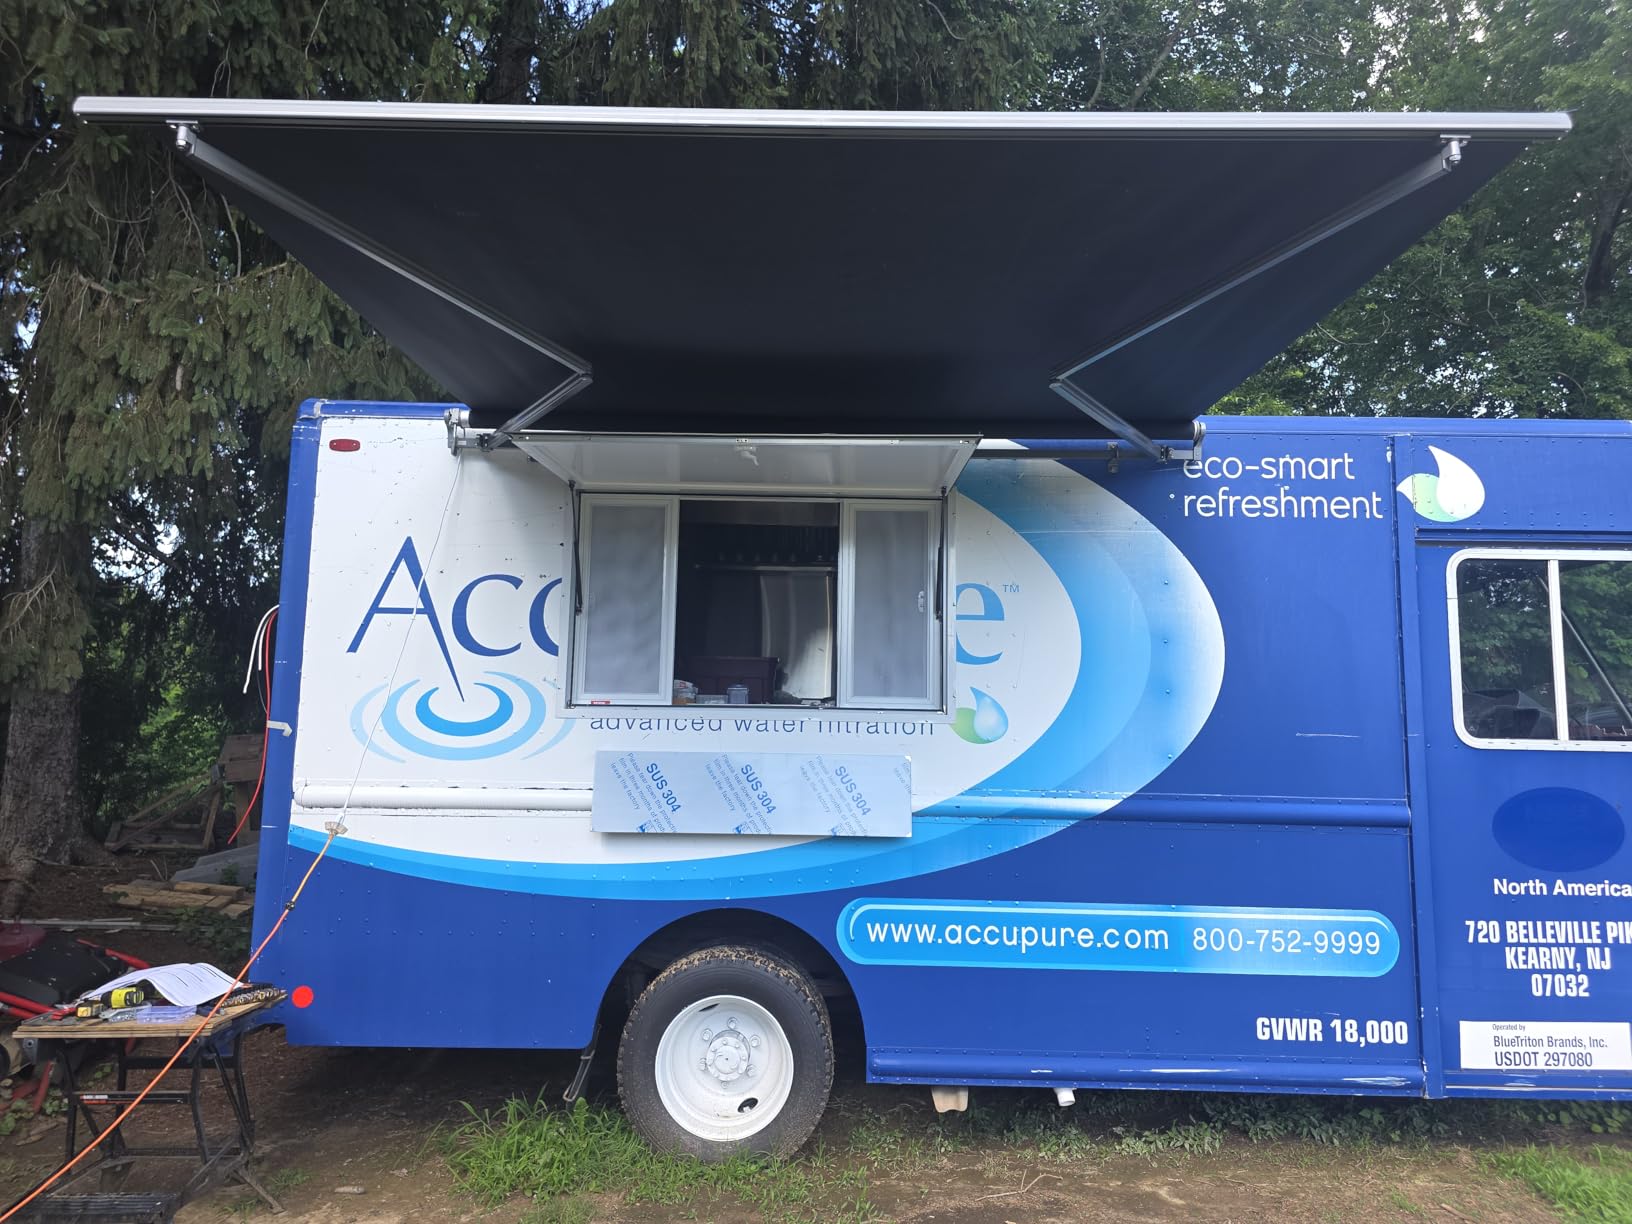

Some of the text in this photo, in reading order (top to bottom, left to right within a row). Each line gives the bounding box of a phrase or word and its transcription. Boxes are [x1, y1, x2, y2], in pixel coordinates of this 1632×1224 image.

[1183, 452, 1355, 480] eco-smart
[1183, 486, 1384, 519] refreshment
[626, 790, 639, 809] factory
[646, 762, 680, 812] SUS 304
[740, 763, 775, 813] SUS 304
[834, 765, 856, 793] SUS
[851, 792, 870, 815] 304
[1494, 879, 1547, 896] North
[867, 920, 1381, 956] www.accupure.com 800-752-9999
[1465, 920, 1500, 943] 720
[1506, 921, 1602, 944] BELLEVILLE
[1505, 947, 1612, 971] KEARNY, NJ
[1531, 974, 1590, 997] 07032
[1257, 1018, 1408, 1047] GVWR 18,000
[1493, 1036, 1608, 1049] BlueTriton Brands, Inc.
[1495, 1051, 1593, 1067] USDOT 297080
